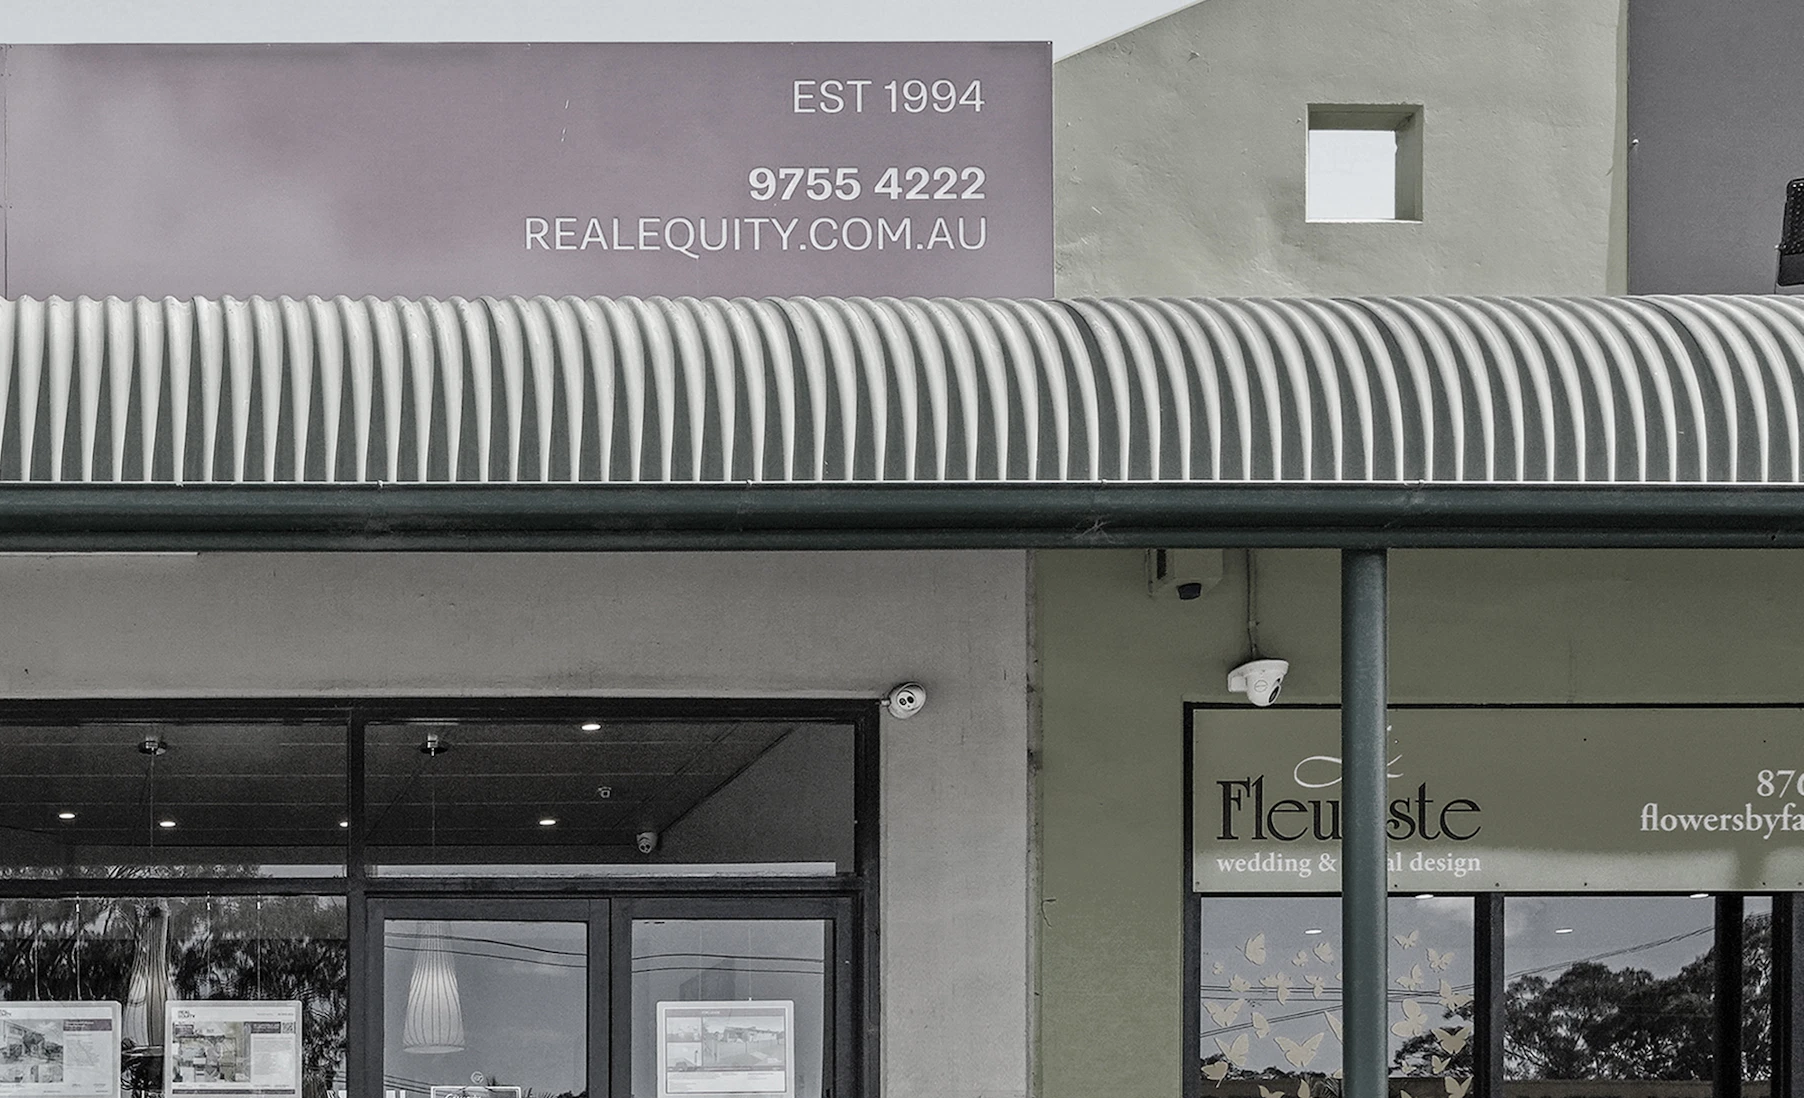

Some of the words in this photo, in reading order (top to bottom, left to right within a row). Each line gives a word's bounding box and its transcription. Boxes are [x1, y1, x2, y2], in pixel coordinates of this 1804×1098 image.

[795, 80, 871, 113] EST
[883, 80, 984, 113] 1994
[748, 166, 860, 199] 9755
[874, 166, 985, 199] 4222
[525, 217, 987, 258] REALEQUITY.COM.AU
[1216, 775, 1481, 841] Fleuste
[1216, 853, 1312, 878] wedding
[1318, 855, 1337, 872] &
[1409, 853, 1481, 878] design
